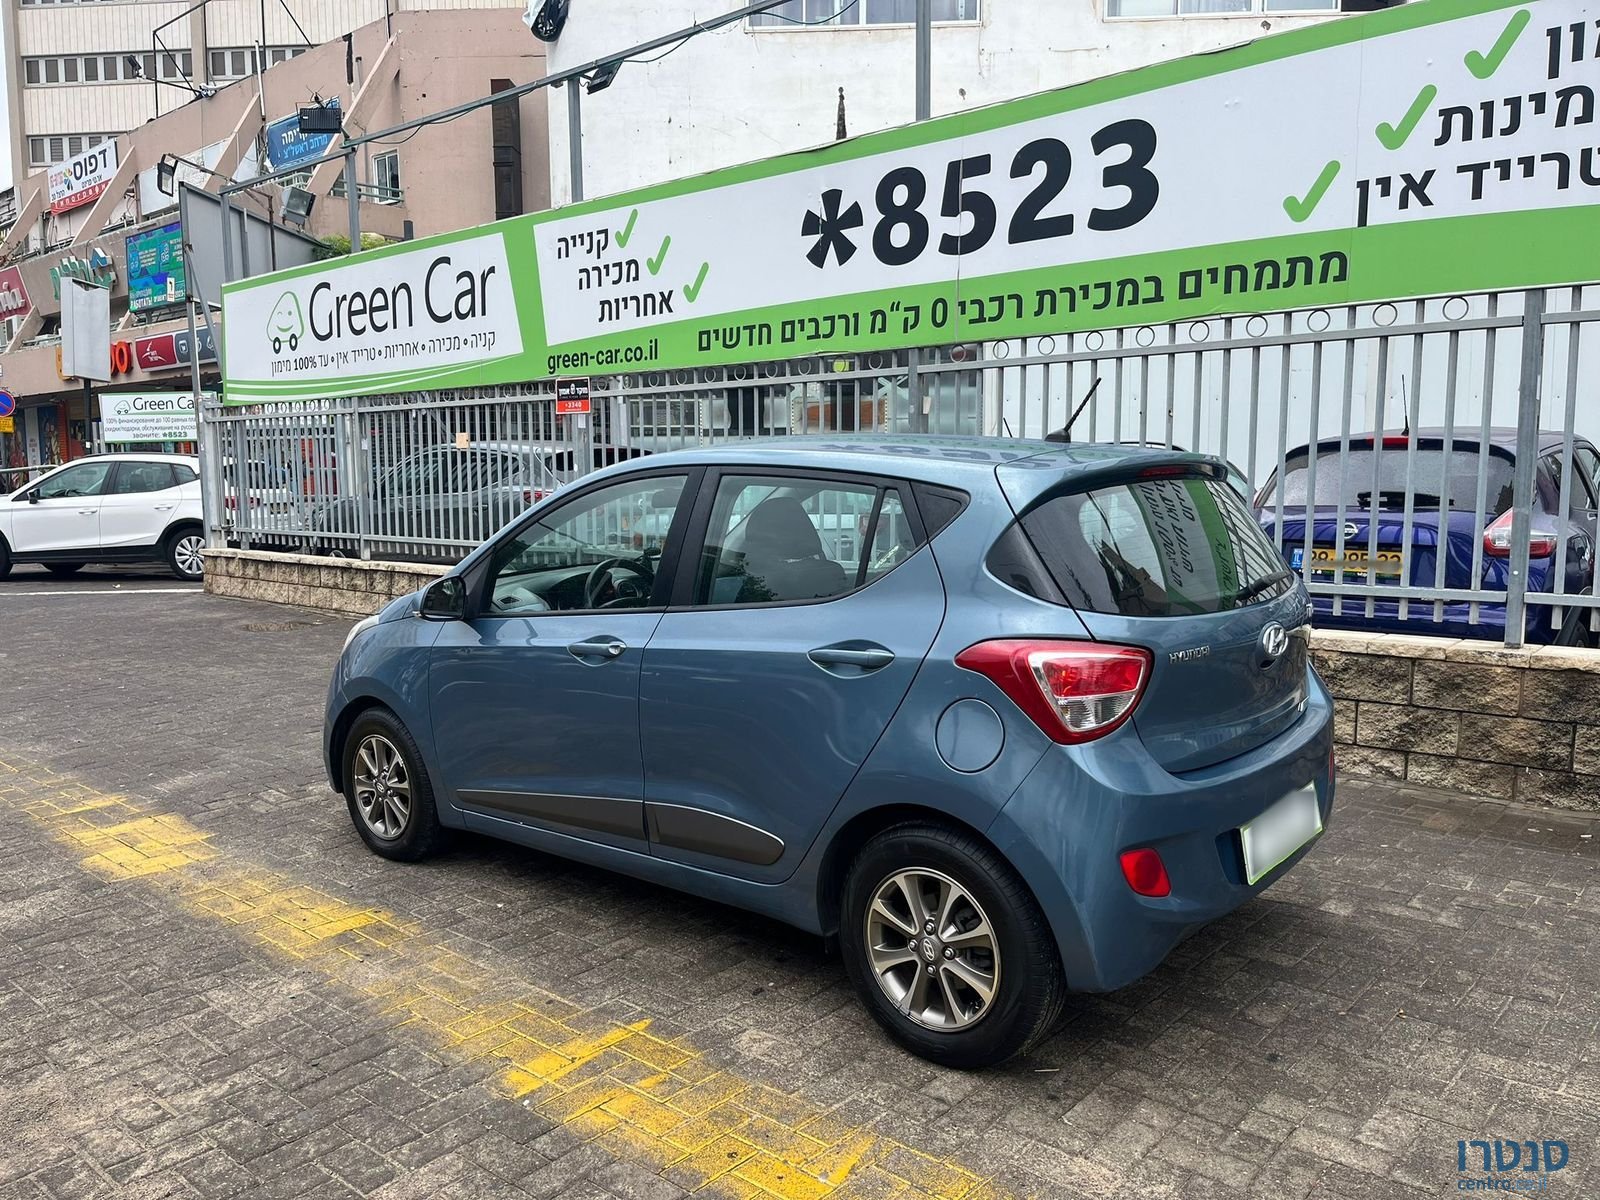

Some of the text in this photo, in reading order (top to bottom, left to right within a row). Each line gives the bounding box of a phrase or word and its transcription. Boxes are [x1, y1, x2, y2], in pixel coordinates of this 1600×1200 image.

[1546, 19, 1600, 80] ון
[73, 148, 107, 181] דפוס
[1356, 169, 1436, 227] אין
[557, 228, 609, 259] קנייה
[578, 259, 640, 290] מכירה
[1178, 250, 1348, 301] מתמחים
[309, 256, 496, 341] Green Car
[598, 290, 674, 322] אחריות
[957, 293, 1024, 325] רכבי
[1034, 275, 1164, 317] במכירת
[781, 312, 859, 343] ורכבים
[931, 297, 948, 328] 0
[698, 323, 772, 351] חדשים
[271, 331, 496, 377] קניה מכירה אחריות טרייד אין עד 100% מימון
[548, 339, 658, 375] green-car.co.il
[133, 396, 195, 411] Green Ca
[1168, 645, 1211, 664] HYUNDAI
